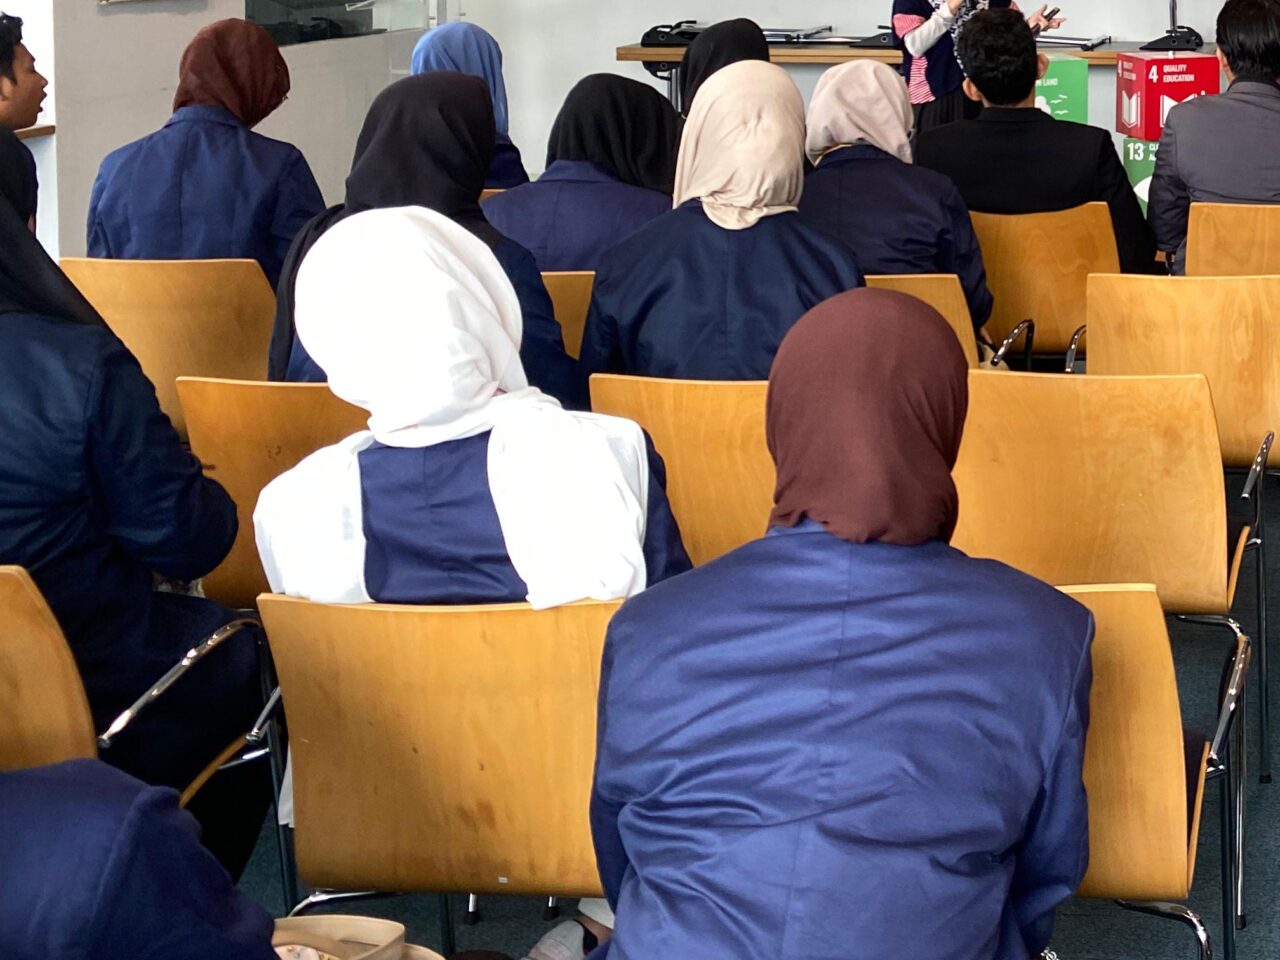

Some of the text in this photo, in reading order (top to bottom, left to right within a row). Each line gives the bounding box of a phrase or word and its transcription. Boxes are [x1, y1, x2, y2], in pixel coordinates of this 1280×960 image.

[1163, 64, 1187, 73] QUALITY
[1148, 65, 1158, 83] 4
[1163, 74, 1194, 83] EDUCATION
[1043, 78, 1058, 86] LAND
[1127, 142, 1145, 161] 13
